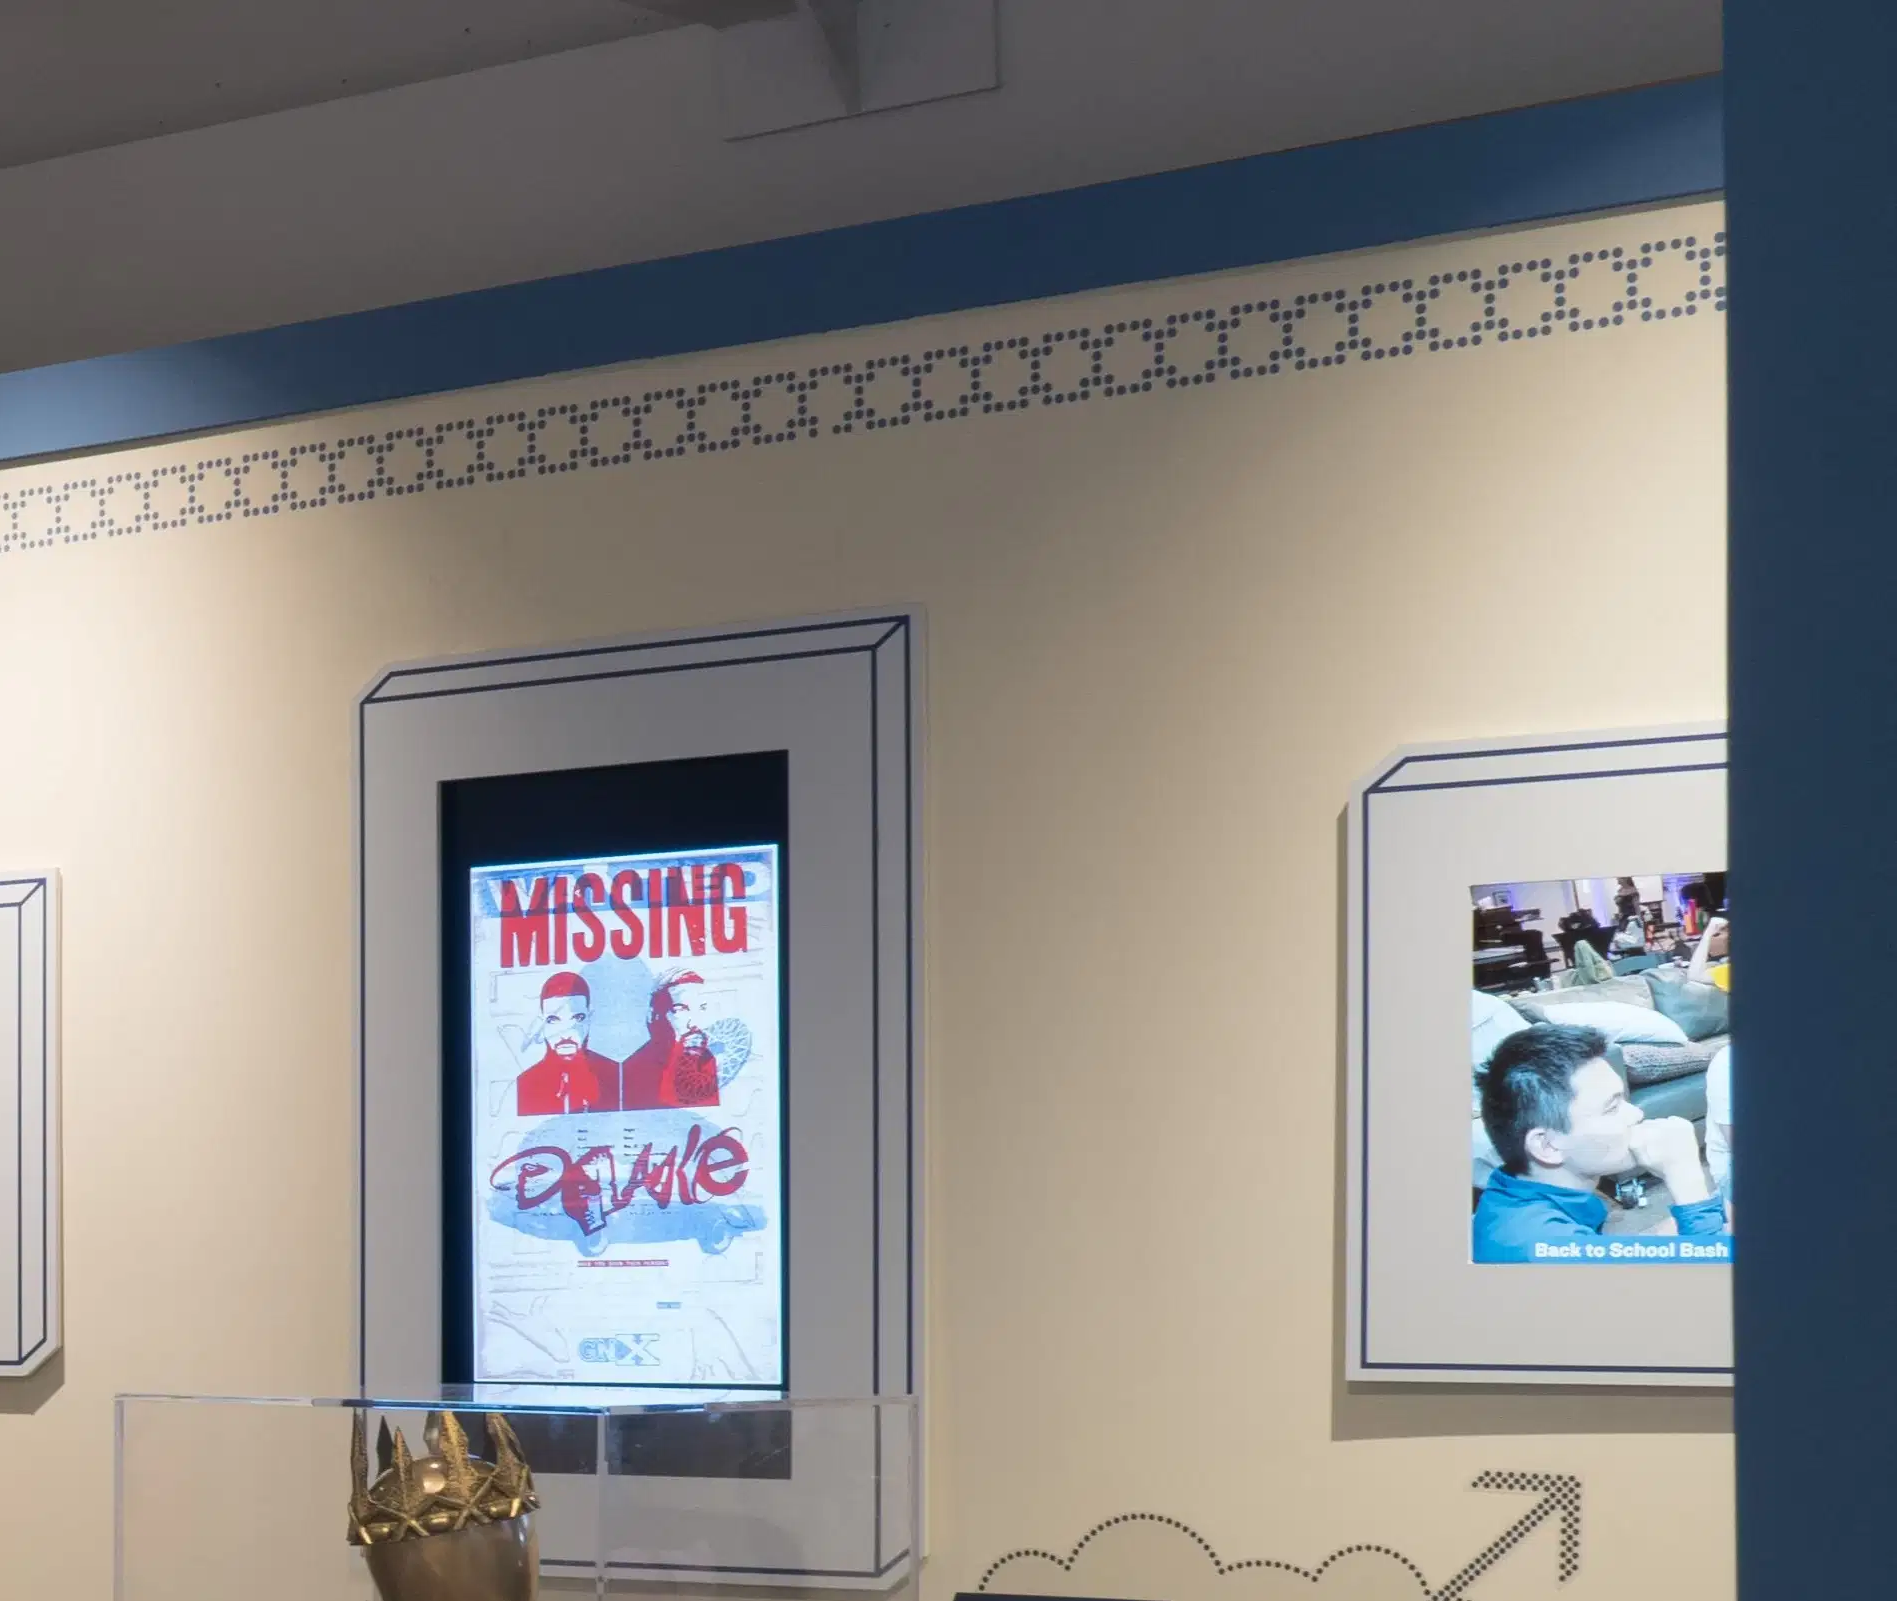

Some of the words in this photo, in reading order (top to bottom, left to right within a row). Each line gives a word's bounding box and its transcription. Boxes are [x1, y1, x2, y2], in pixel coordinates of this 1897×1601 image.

[499, 863, 748, 969] MISSING
[1535, 1242, 1581, 1259] Back
[1585, 1243, 1605, 1259] to
[1609, 1242, 1675, 1259] School
[1680, 1242, 1728, 1259] Bash
